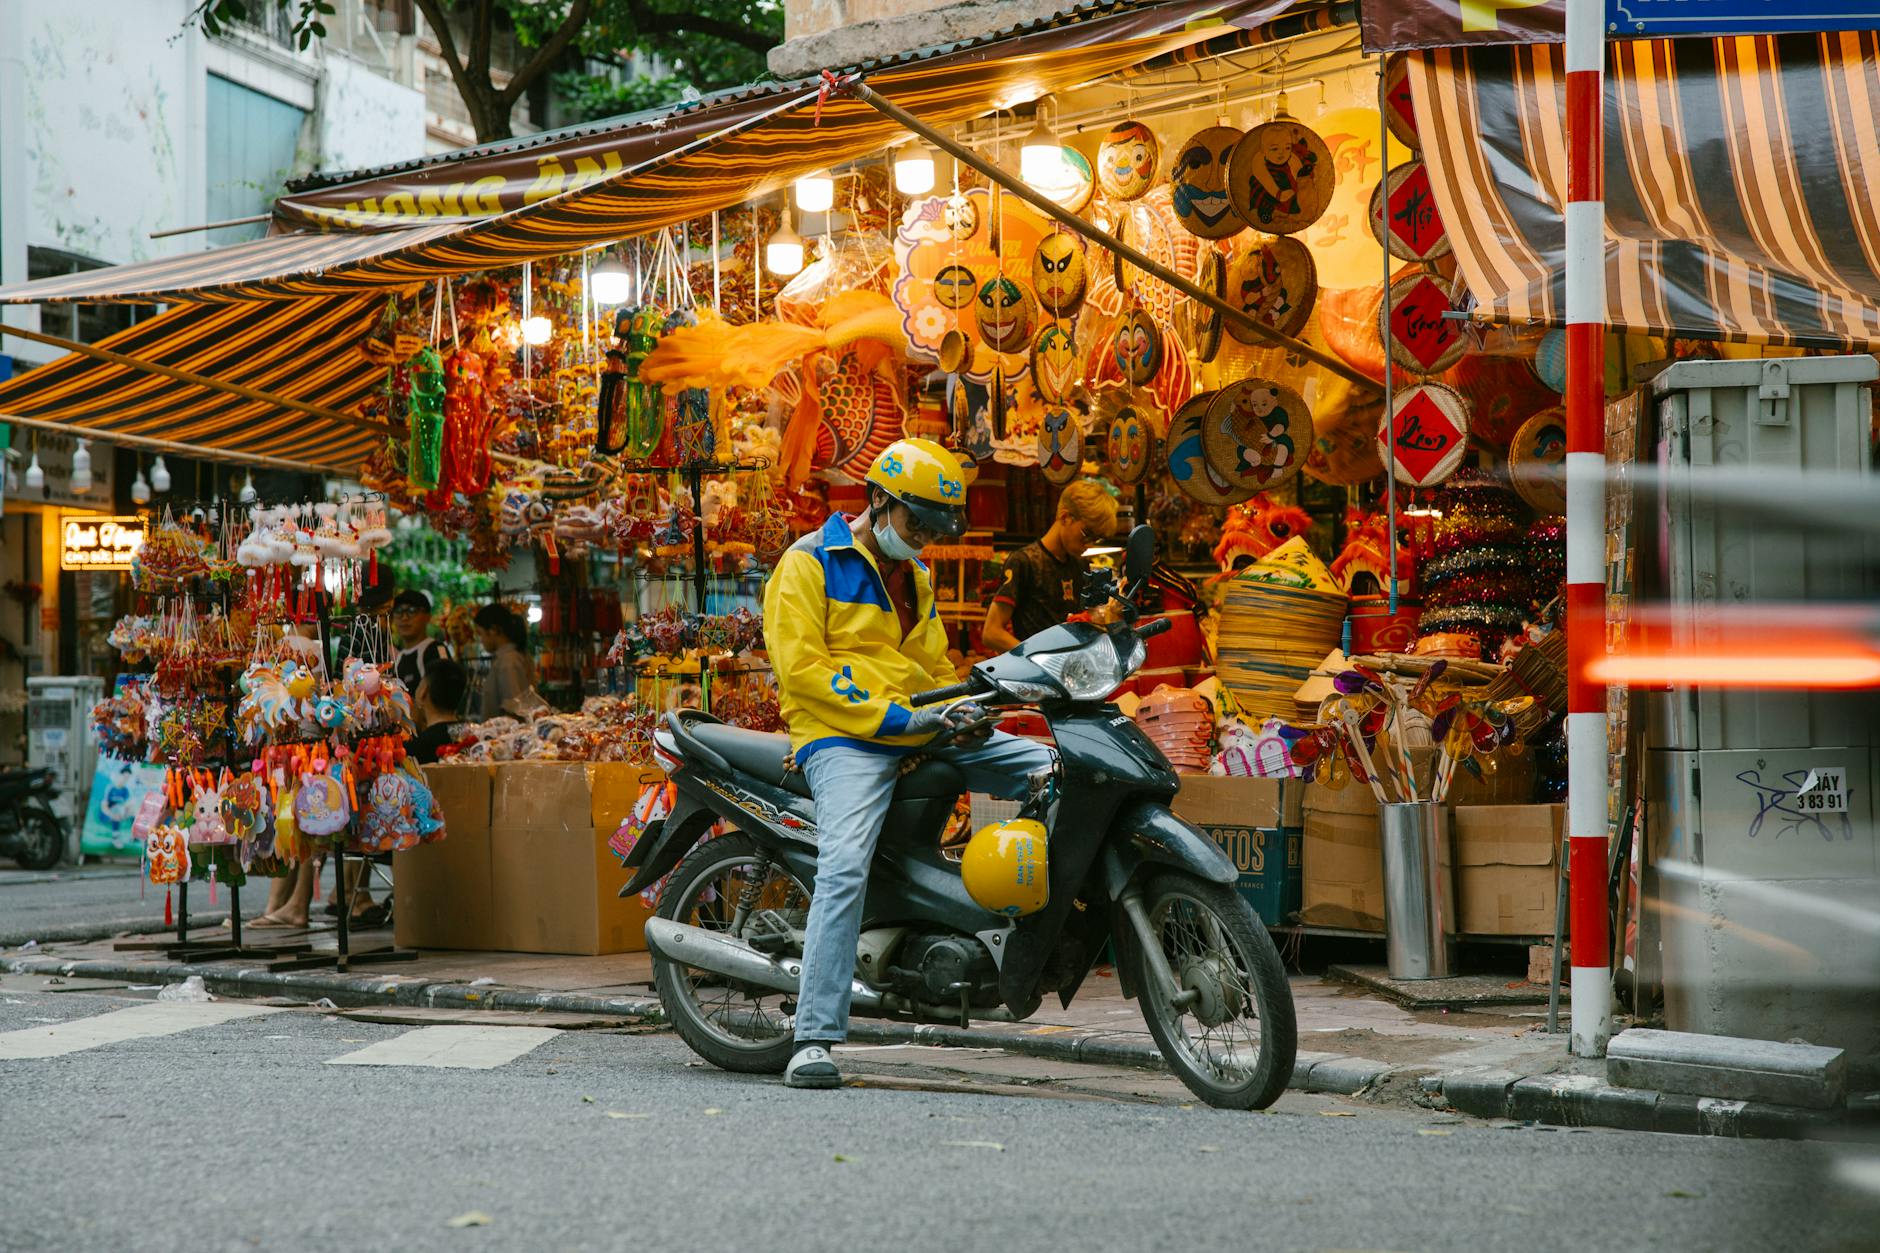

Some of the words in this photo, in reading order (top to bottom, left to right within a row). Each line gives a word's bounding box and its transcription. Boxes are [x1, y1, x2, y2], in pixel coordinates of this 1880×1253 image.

[938, 473, 962, 498] be
[831, 665, 870, 704] be
[1809, 794, 1823, 809] 83
[1828, 794, 1842, 808] 91
